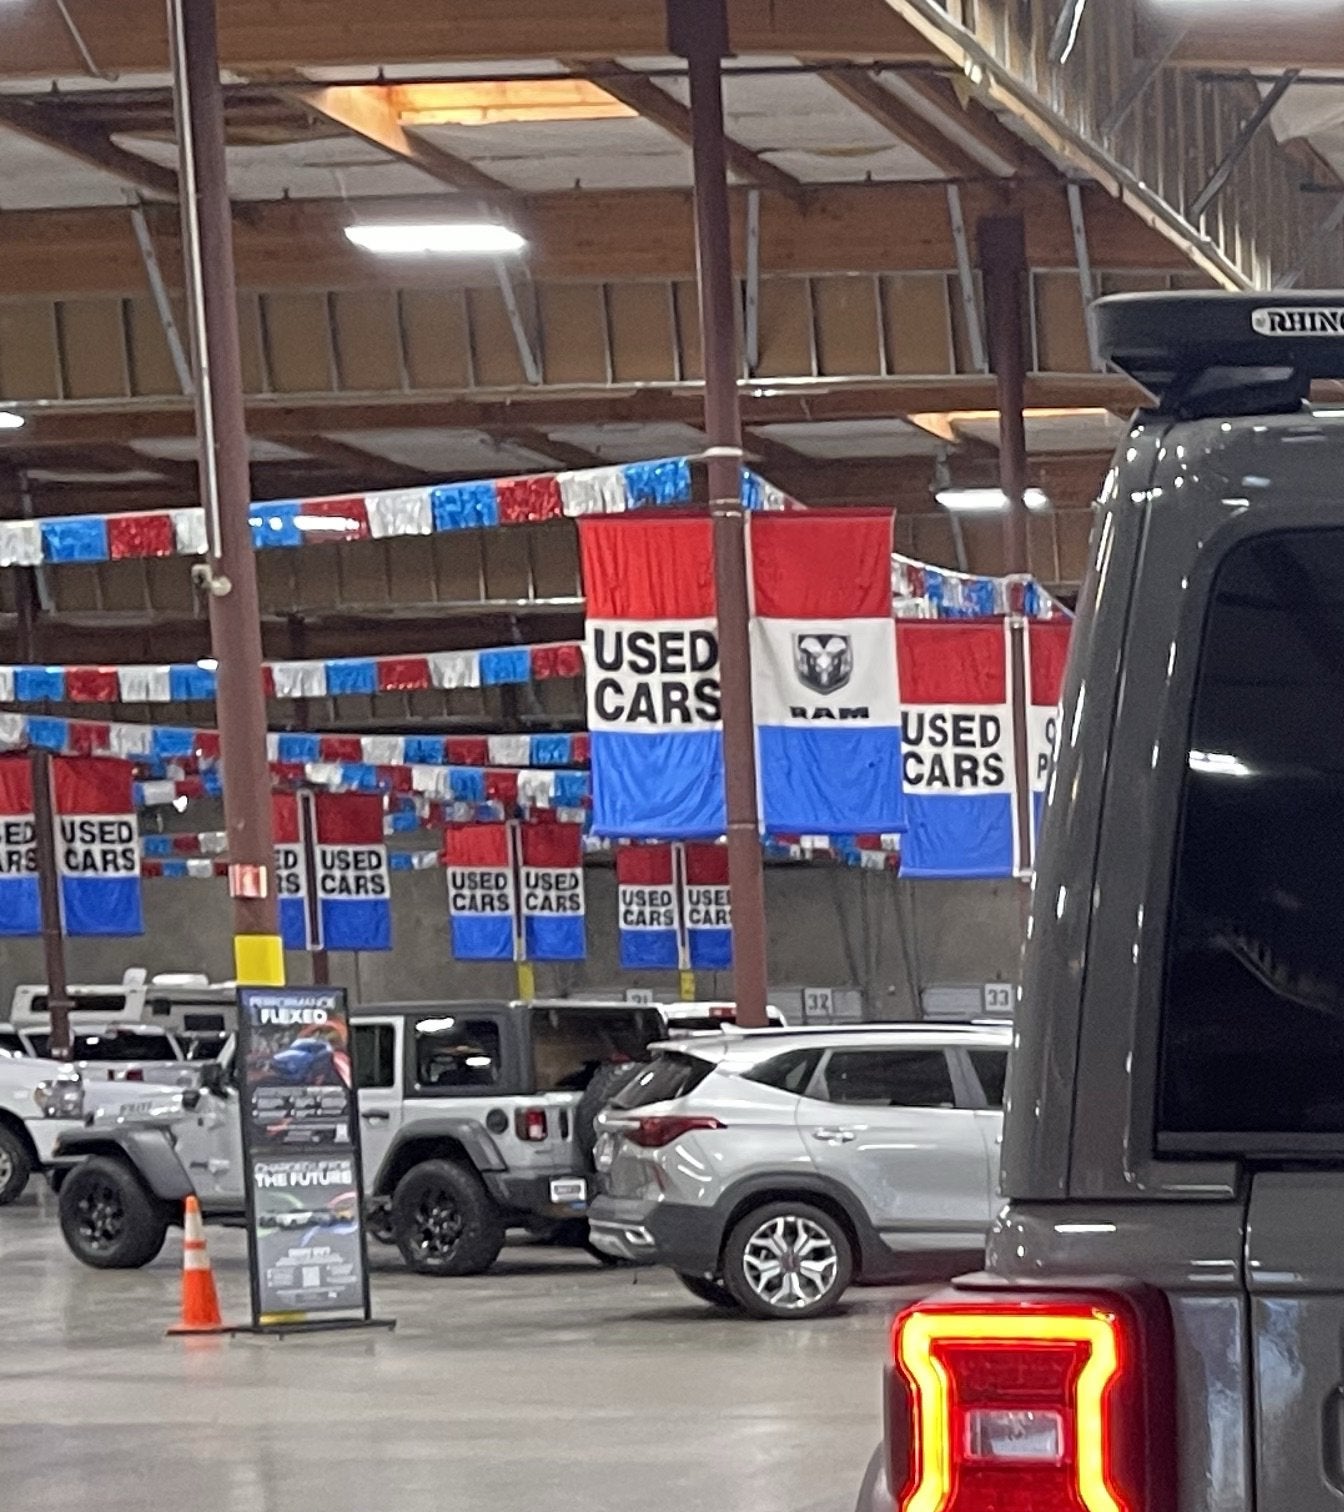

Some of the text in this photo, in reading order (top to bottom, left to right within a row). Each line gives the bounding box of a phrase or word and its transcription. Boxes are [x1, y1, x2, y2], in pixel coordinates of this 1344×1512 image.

[594, 629, 719, 675] USED
[594, 678, 722, 724] CARS
[790, 706, 870, 720] RAM
[901, 711, 1001, 748] USED
[903, 751, 1005, 787] CARS
[61, 820, 133, 845] USED
[65, 848, 136, 872] CARS
[321, 849, 383, 870] USED
[321, 873, 385, 895] CARS
[451, 871, 508, 891] USED
[525, 871, 579, 891] USED
[452, 893, 510, 912] CARS
[525, 892, 581, 912] CARS
[622, 889, 673, 907] USED
[623, 909, 674, 926] CARS
[688, 909, 731, 925] CAR
[988, 989, 1010, 1007] 33
